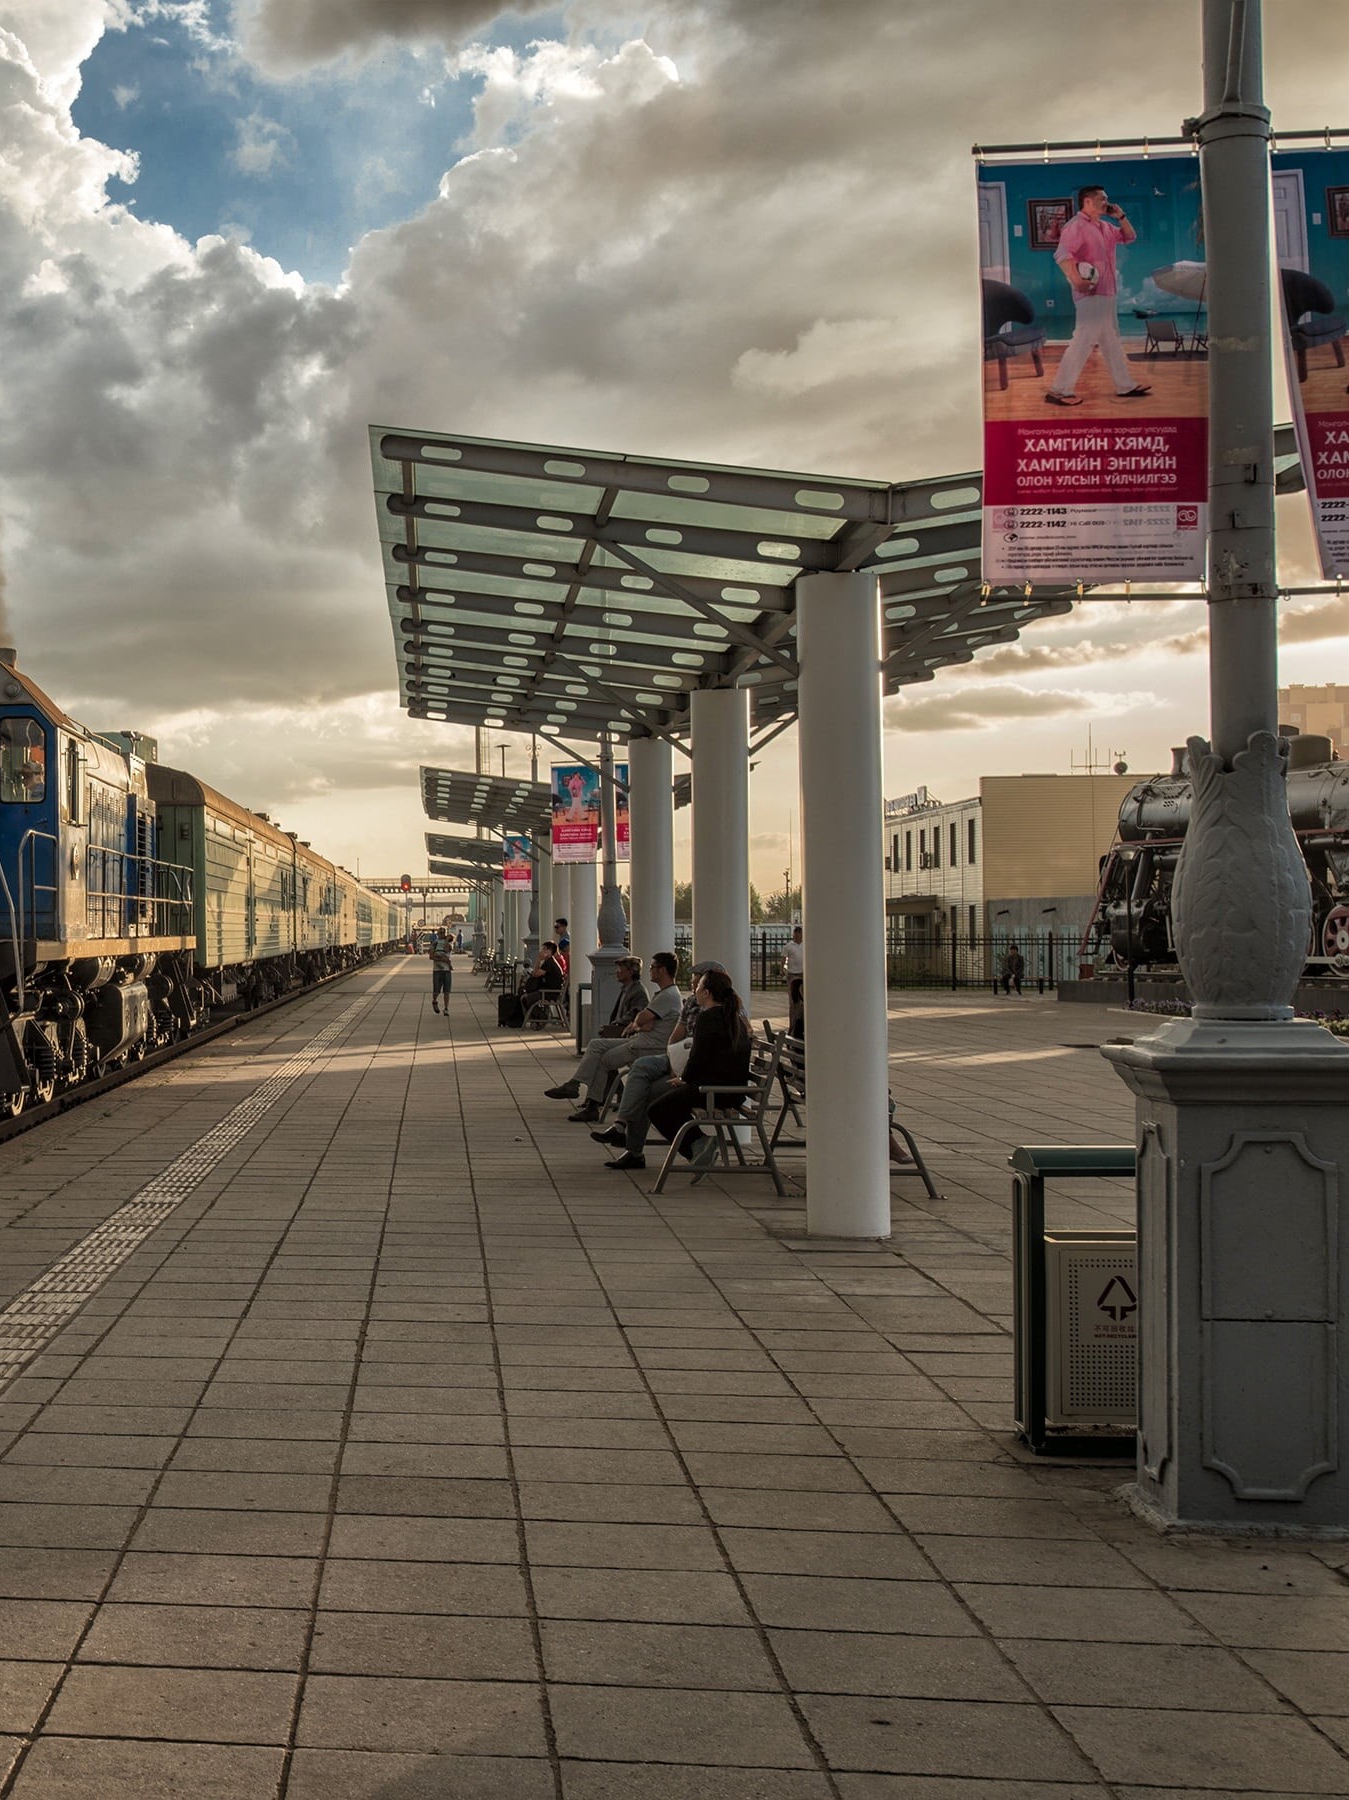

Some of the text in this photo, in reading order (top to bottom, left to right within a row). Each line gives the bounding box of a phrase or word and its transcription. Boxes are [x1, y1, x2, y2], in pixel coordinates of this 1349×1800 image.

[1024, 434, 1170, 452] ХАМГИЙН ХЯМД,
[1017, 453, 1177, 472] ХАМГИЙН ЭНГИЙН
[1017, 476, 1052, 486] ОЛОН
[1056, 475, 1100, 486] УЛСЫН
[1020, 507, 1067, 516] 2222-1143
[1020, 520, 1067, 528] 2222-1142
